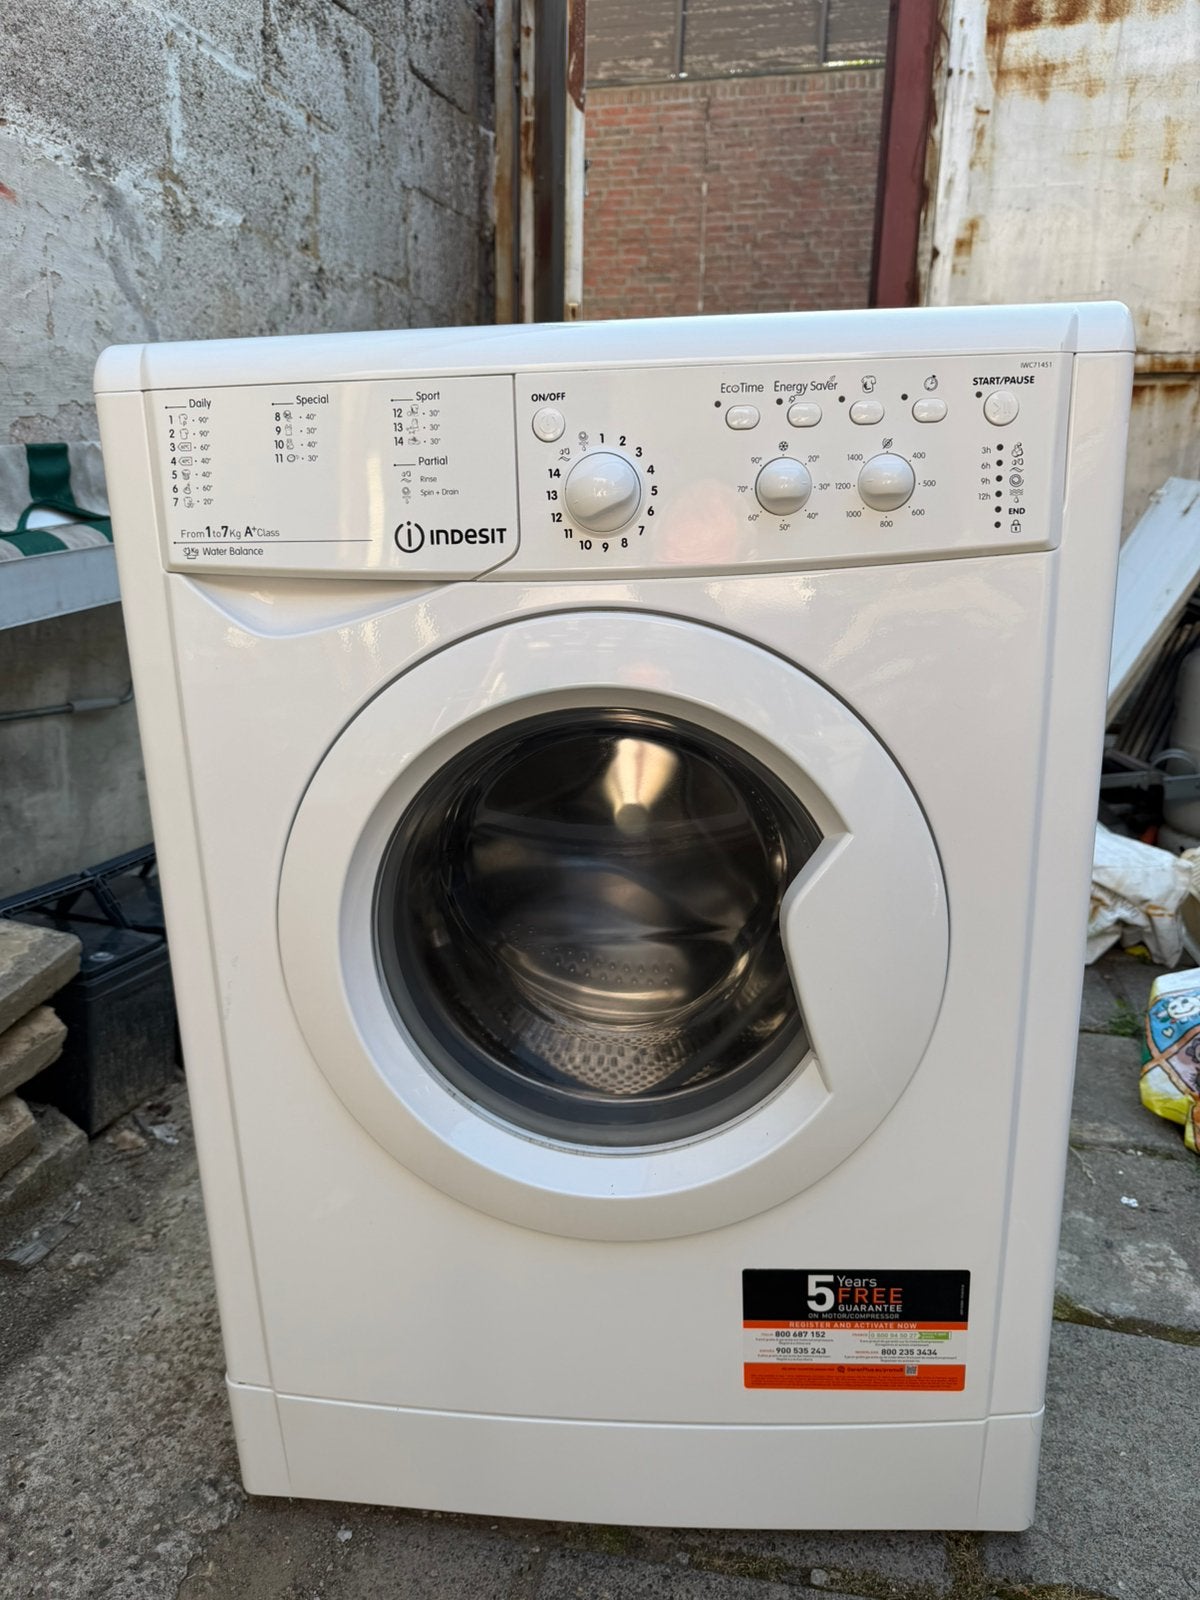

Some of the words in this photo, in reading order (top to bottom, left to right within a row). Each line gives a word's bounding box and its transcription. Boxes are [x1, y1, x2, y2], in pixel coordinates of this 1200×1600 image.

[972, 375, 1035, 386] START/PAUSE
[720, 383, 764, 393] EcoTime
[773, 380, 808, 394] Energy
[810, 380, 838, 391] Saver
[296, 394, 329, 406] Special
[416, 391, 440, 403] Sport
[531, 392, 566, 402] ON/OFF
[189, 398, 212, 409] Daily
[275, 412, 281, 422] 8
[392, 408, 403, 418] 12
[169, 415, 173, 424] 1
[275, 426, 281, 435] 9
[393, 422, 403, 432] 13
[169, 429, 175, 438] 2
[599, 433, 605, 443] 1
[274, 440, 284, 449] 10
[394, 436, 404, 446] 14
[619, 435, 626, 446] 2
[170, 442, 176, 452] 3
[635, 447, 643, 457] 3
[981, 446, 991, 454] 3h
[171, 457, 177, 466] 4
[275, 453, 283, 463] 11
[418, 456, 448, 466] Partial
[647, 464, 655, 475] 4
[981, 462, 991, 470] 6h
[172, 470, 178, 480] 5
[548, 468, 561, 479] 14
[980, 477, 990, 485] 9h
[172, 484, 179, 493] 6
[420, 489, 435, 497] Spin
[651, 486, 658, 496] 5
[546, 490, 558, 500] 13
[173, 497, 179, 507] 7
[647, 506, 655, 516] 6
[1008, 507, 1026, 515] END
[551, 512, 563, 523] 12
[880, 520, 893, 528] 800
[181, 529, 205, 538] From
[205, 526, 211, 538] 1
[212, 530, 221, 538] to
[221, 525, 229, 538] 7
[229, 529, 241, 540] Kg
[257, 528, 280, 537] Class
[564, 529, 573, 539] 11
[638, 526, 645, 536] 7
[579, 540, 592, 550] 10
[602, 542, 609, 552] 9
[621, 538, 628, 548] 8
[202, 546, 227, 556] Water
[229, 546, 264, 556] Balance
[807, 1274, 835, 1312] 5
[837, 1275, 877, 1287] Years
[838, 1288, 903, 1303] FREE
[838, 1304, 903, 1312] GUARANTEE
[789, 1321, 831, 1329] REGISTER
[833, 1321, 851, 1329] AND
